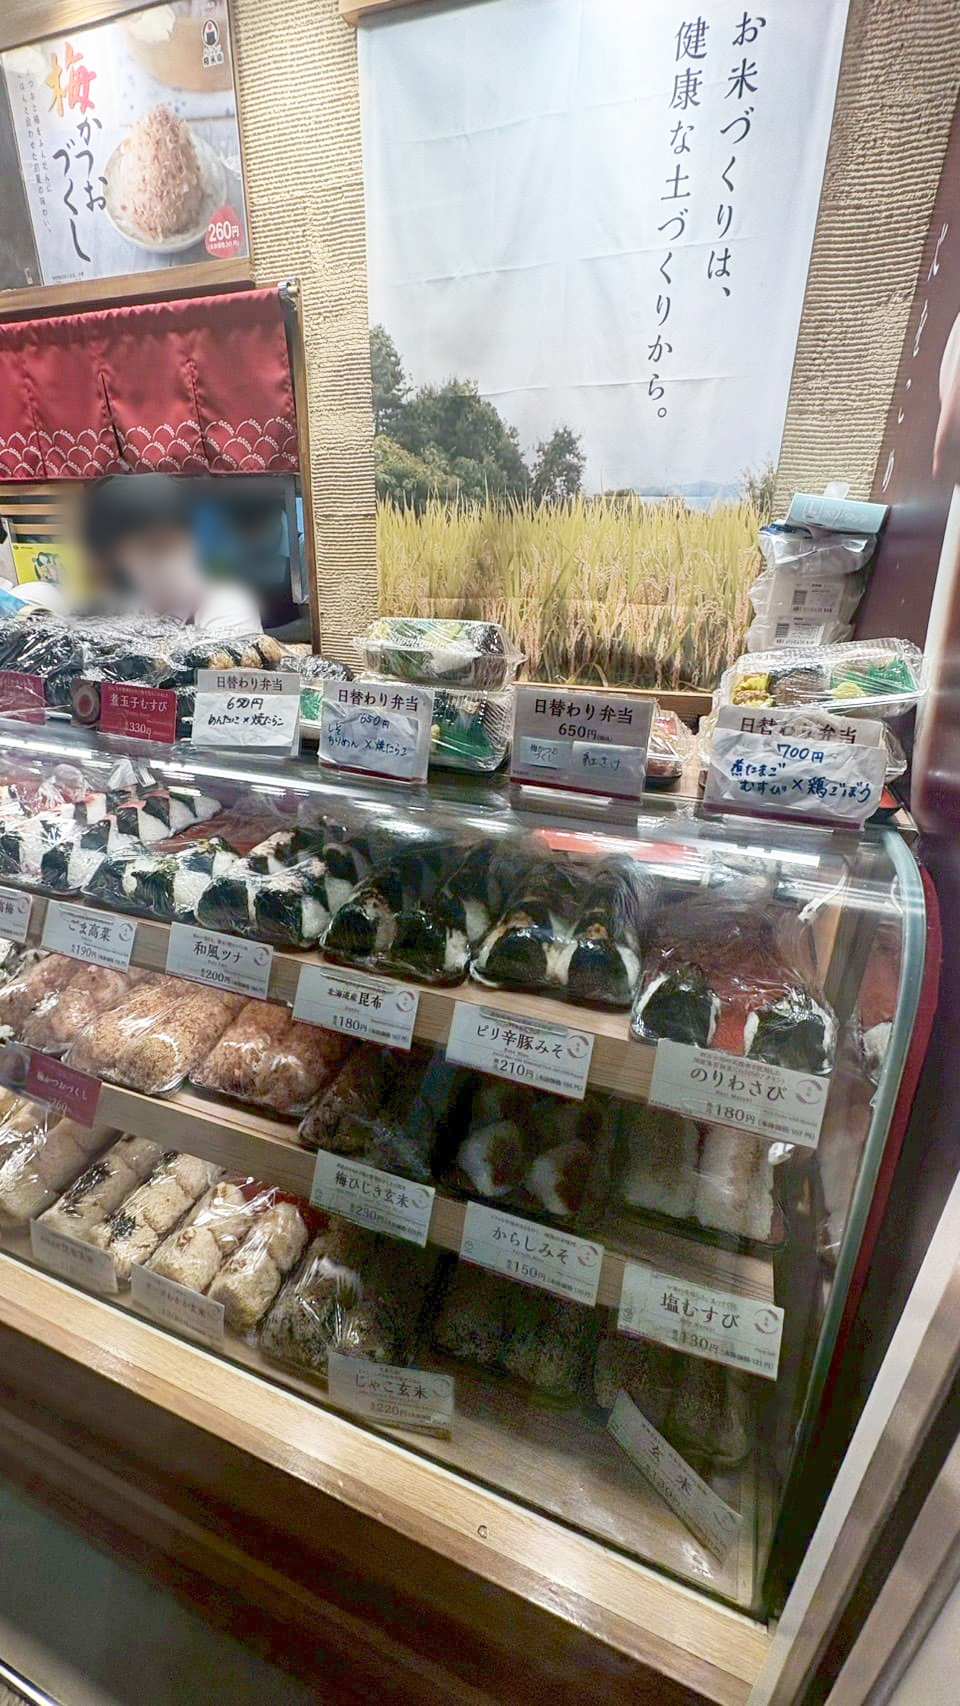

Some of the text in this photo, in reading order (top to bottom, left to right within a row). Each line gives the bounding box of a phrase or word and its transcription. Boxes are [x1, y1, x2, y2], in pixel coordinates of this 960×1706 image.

[707, 11, 767, 297] お米づくりは、
[647, 15, 711, 419] 健康な土づくりから。
[208, 221, 240, 242] 260円
[216, 675, 283, 692] 日替わり弁当
[111, 693, 168, 712] 煮玉子むすび
[338, 689, 419, 712] 日替わり弁当
[534, 699, 633, 725] 日替わり弁当
[558, 723, 597, 740] 650円
[776, 743, 825, 763] 700円
[730, 758, 786, 777] 煮たまご
[68, 919, 112, 942] ごま高菜
[193, 941, 243, 963] 和風ツナ
[206, 969, 231, 984] 200円
[339, 1016, 368, 1033] 180円
[476, 1024, 564, 1059] ピリ辛豚みそ
[499, 1058, 534, 1080] 210円
[690, 1067, 788, 1101] のりわさび
[715, 1103, 756, 1125] 180円
[335, 1170, 409, 1209] 梅ひじき玄米
[492, 1227, 569, 1265] からしみそ
[514, 1261, 546, 1281] 150円
[660, 1292, 740, 1329] 塩むすび
[680, 1331, 720, 1354] 130円
[355, 1373, 428, 1400] じゃこ玄米
